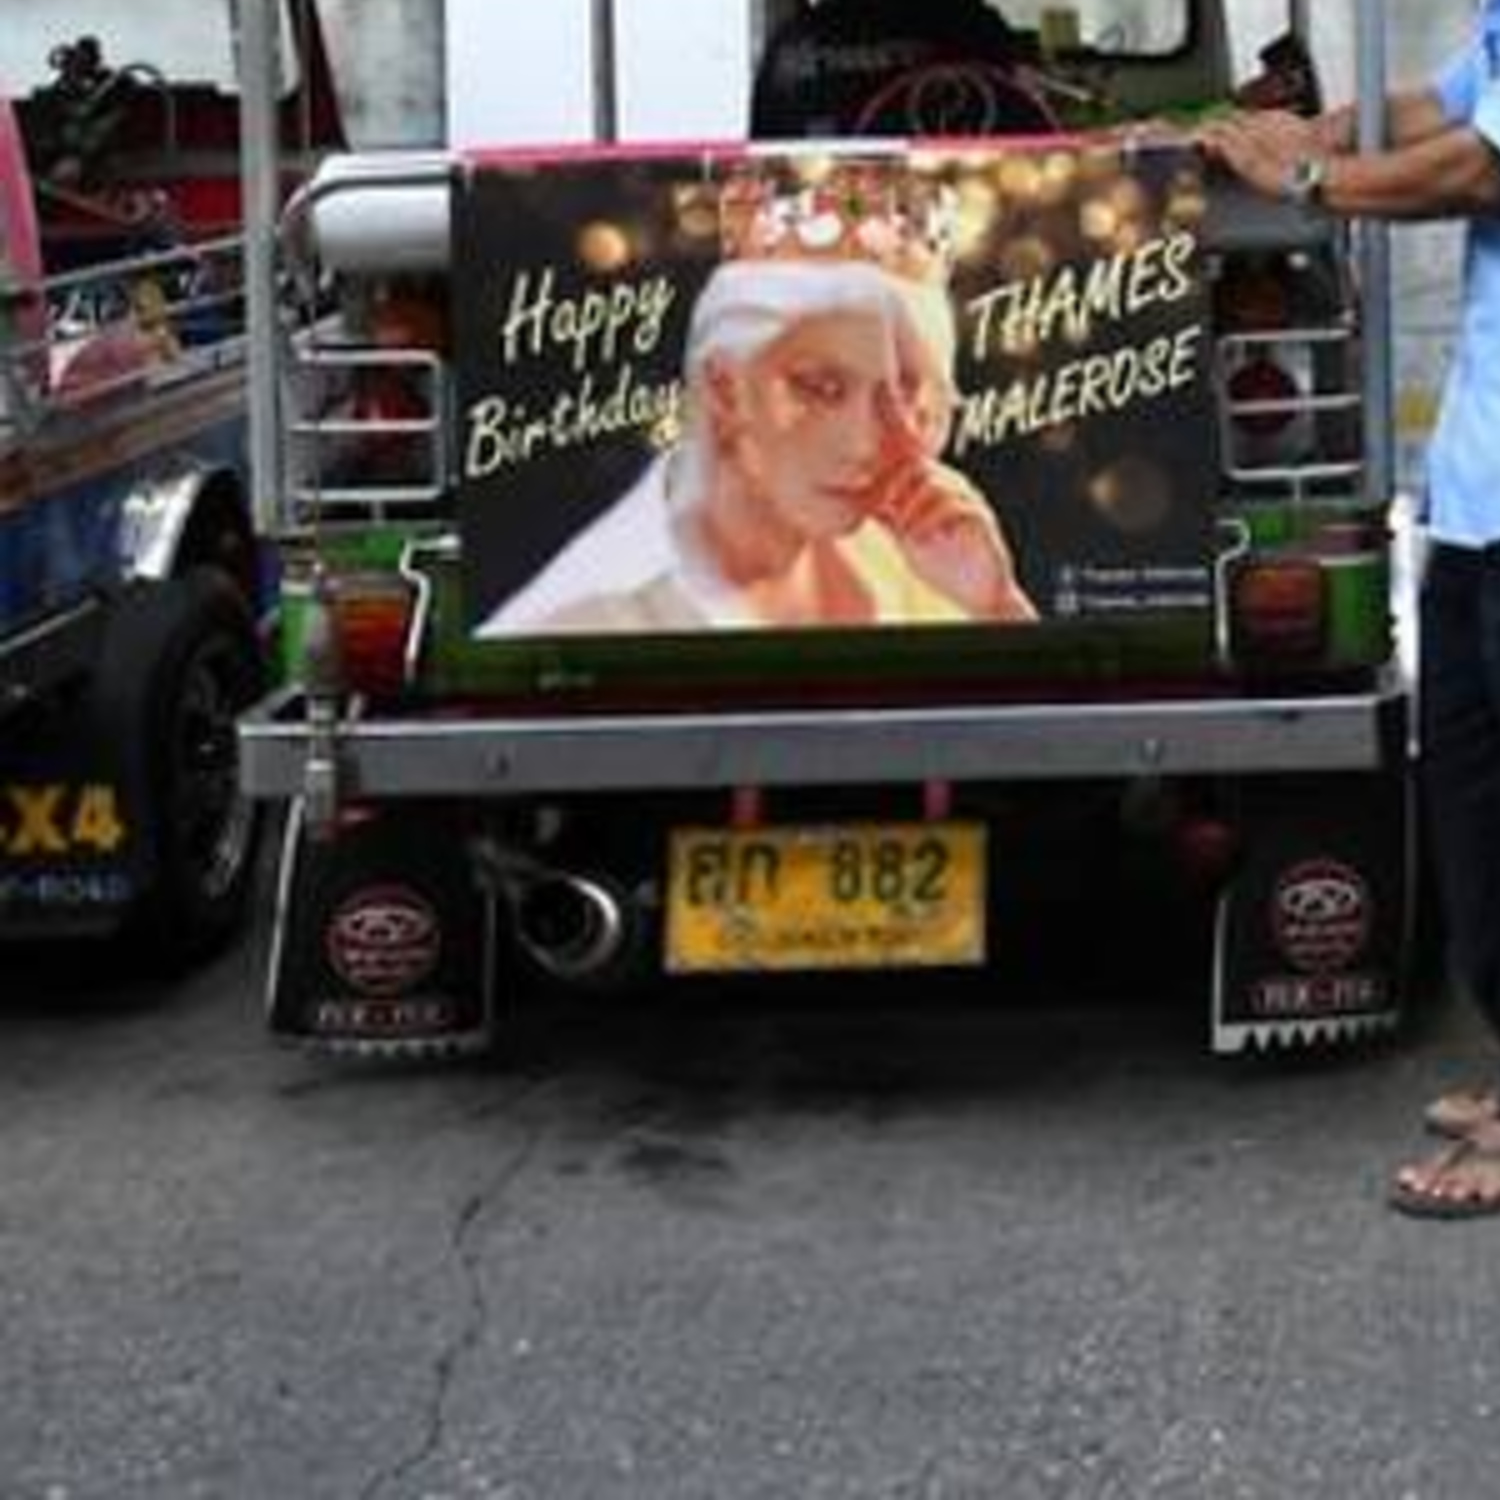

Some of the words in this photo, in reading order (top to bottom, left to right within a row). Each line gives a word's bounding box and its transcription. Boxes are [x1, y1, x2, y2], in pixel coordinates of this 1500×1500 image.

[502, 266, 676, 372] Happy
[966, 232, 1196, 361] THAMES
[465, 362, 682, 478] Birthday
[954, 323, 1202, 457] MALEROSE
[0, 781, 125, 853] X4
